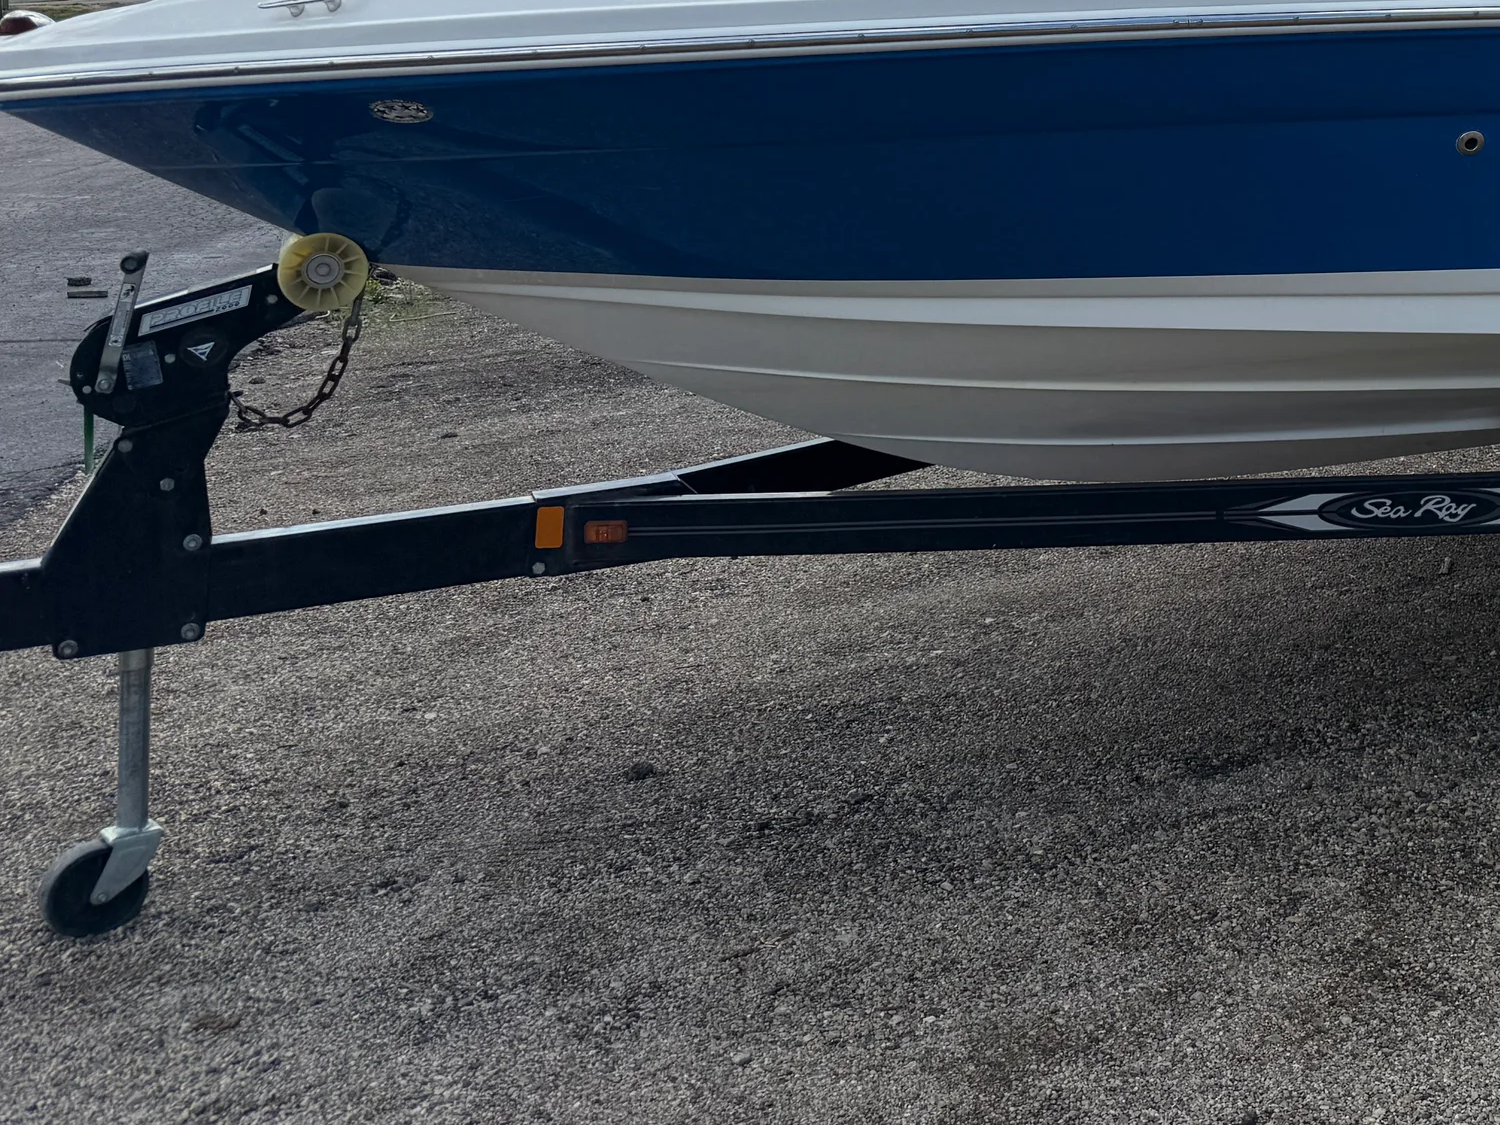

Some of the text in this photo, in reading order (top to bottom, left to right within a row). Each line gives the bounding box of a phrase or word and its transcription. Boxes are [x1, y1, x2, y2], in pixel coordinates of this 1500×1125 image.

[149, 290, 243, 327] PROFILE
[1350, 495, 1478, 523] Sea Ray
